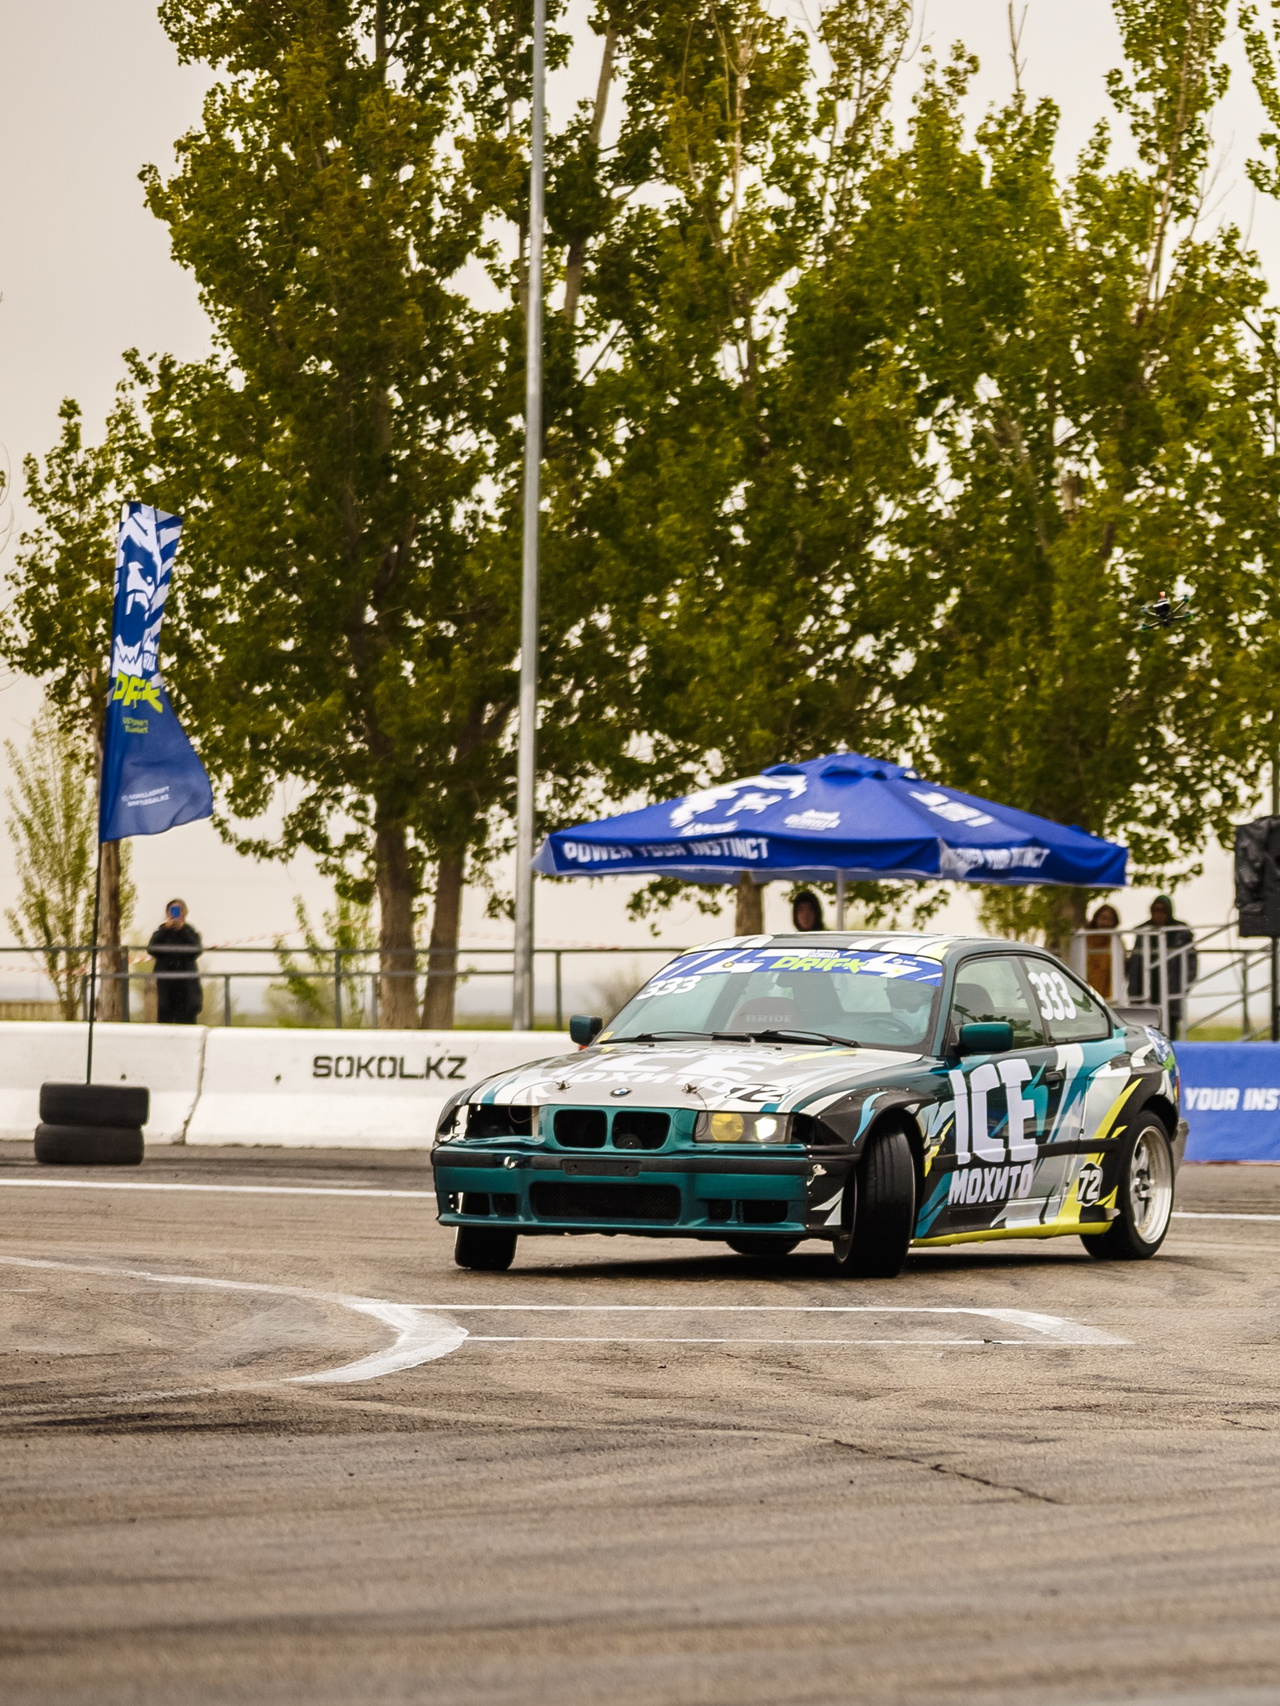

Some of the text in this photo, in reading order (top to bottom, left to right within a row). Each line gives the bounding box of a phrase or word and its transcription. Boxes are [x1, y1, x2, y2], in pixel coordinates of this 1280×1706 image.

[563, 837, 769, 864] POWER YOUR INSTINCT
[637, 975, 702, 1000] 333
[1028, 972, 1077, 1021] 333
[745, 1014, 793, 1023] BRIDE
[312, 1055, 468, 1079] SOKOL.KZ
[725, 1084, 791, 1102] 72
[1184, 1087, 1241, 1112] YOUR
[948, 1058, 1039, 1165] ICE
[948, 1163, 1034, 1206] МОХИТО
[1077, 1169, 1101, 1203] 72
